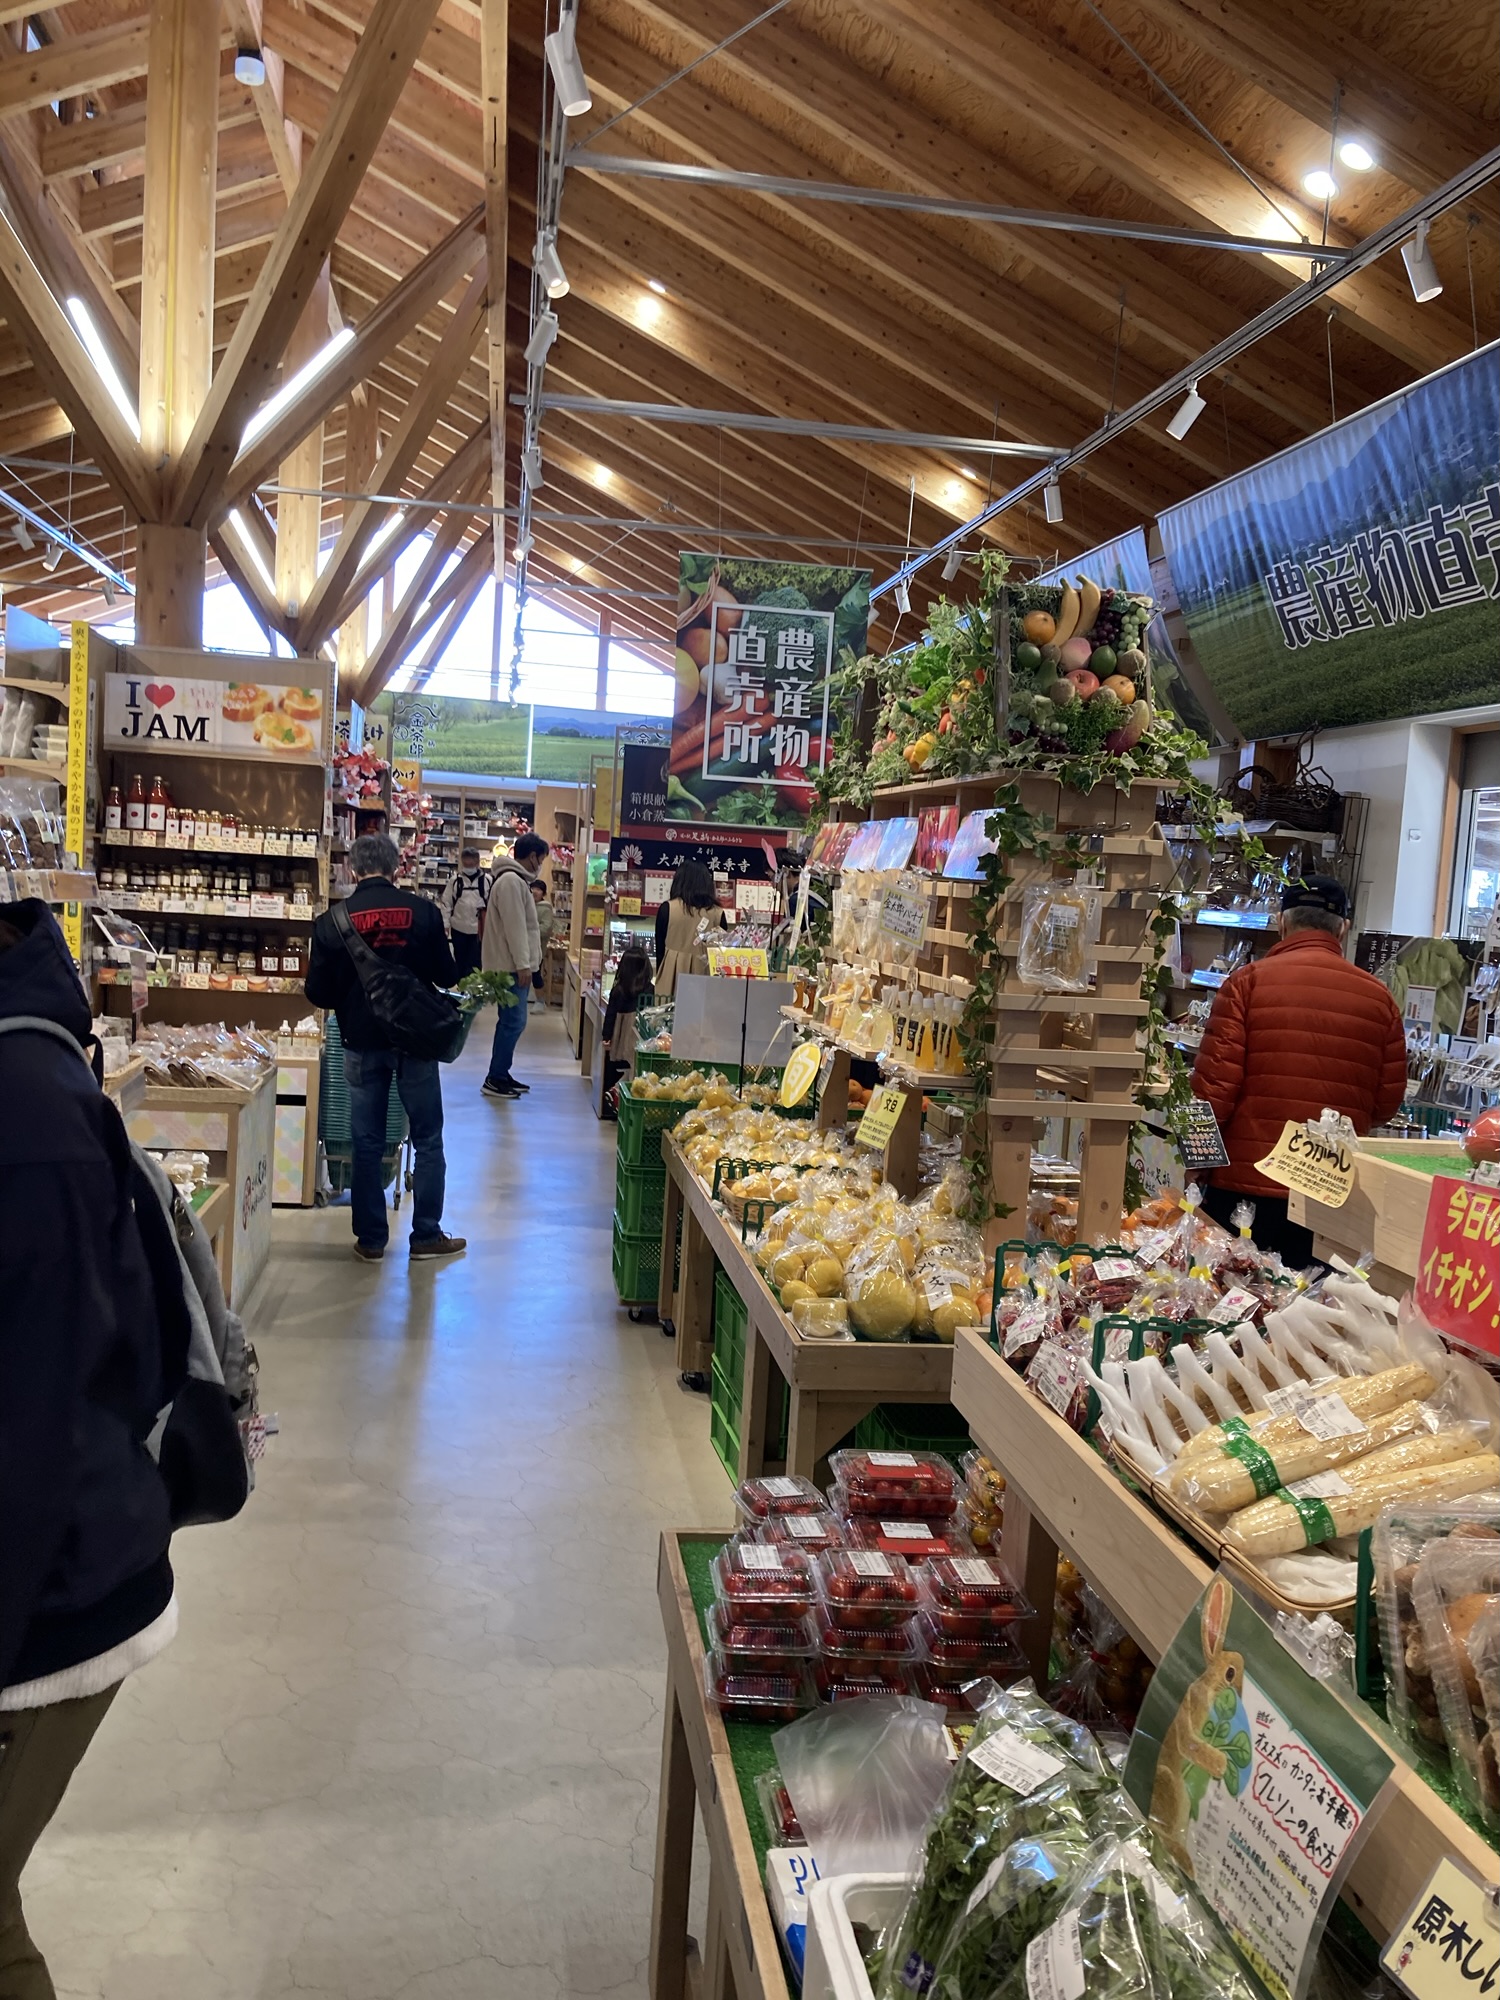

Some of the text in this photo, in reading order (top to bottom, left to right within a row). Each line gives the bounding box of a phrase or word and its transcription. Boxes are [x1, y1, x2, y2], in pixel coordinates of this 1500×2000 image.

[126, 681, 141, 708] I
[720, 626, 767, 764] 直売所
[769, 628, 815, 768] 農産物
[121, 711, 210, 742] JAM
[351, 911, 407, 930] IMPSON
[1288, 1130, 1351, 1173] とうがらし
[1259, 1773, 1337, 1869] クレソンの食べ方
